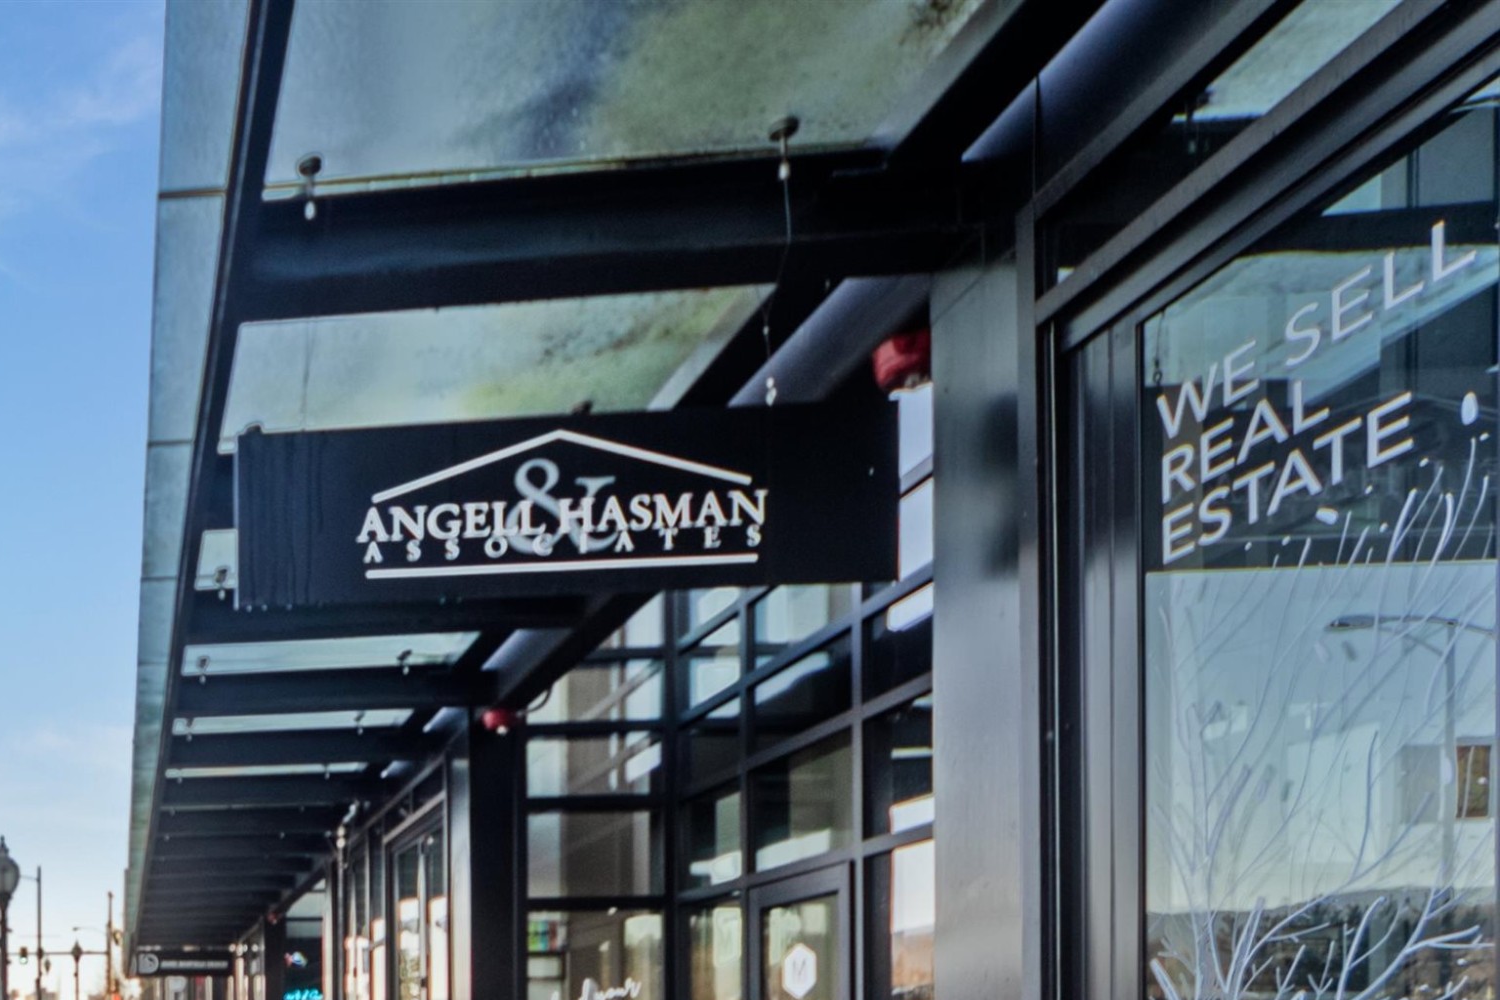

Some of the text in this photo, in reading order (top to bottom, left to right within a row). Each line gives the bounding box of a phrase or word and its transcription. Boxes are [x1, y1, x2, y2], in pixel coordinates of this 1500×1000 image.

[1157, 220, 1477, 438] WE SELL
[1162, 380, 1330, 504] REAL
[1162, 391, 1414, 565] ESTATE
[357, 500, 547, 543] ANGELL
[556, 489, 768, 535] HASMAN
[363, 524, 762, 564] ASSOCIATES
